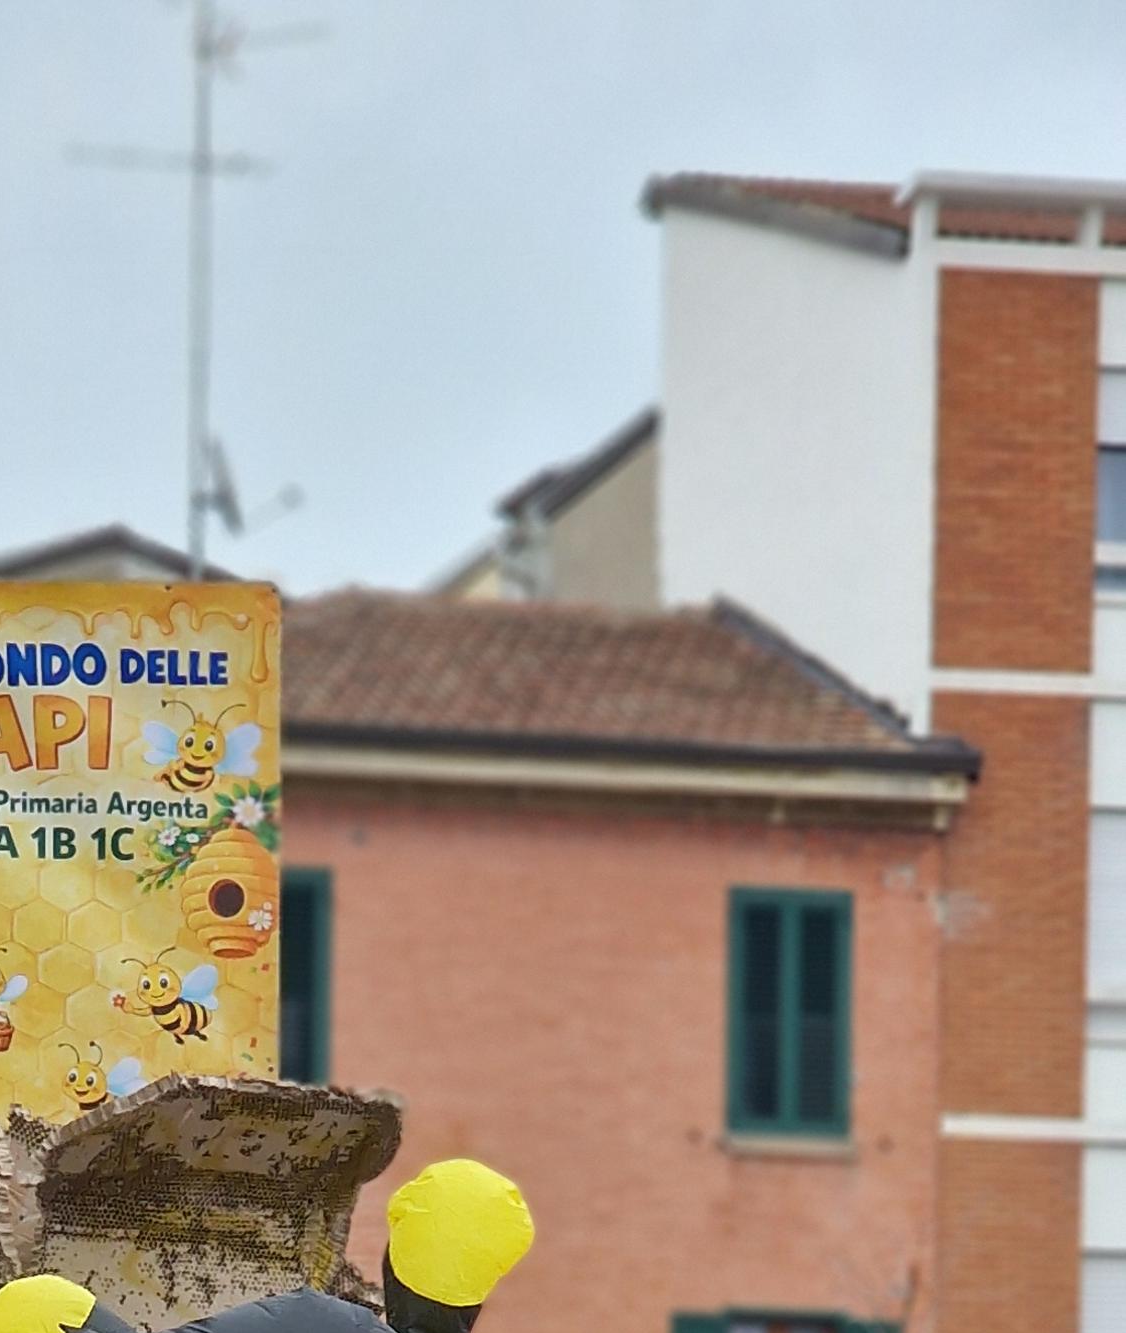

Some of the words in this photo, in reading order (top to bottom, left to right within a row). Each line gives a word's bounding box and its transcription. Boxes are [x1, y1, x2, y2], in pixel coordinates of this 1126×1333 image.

[119, 648, 229, 685] DELLE
[107, 791, 208, 821] Argenta
[30, 825, 77, 860] 1B
[90, 827, 135, 861] 1C
